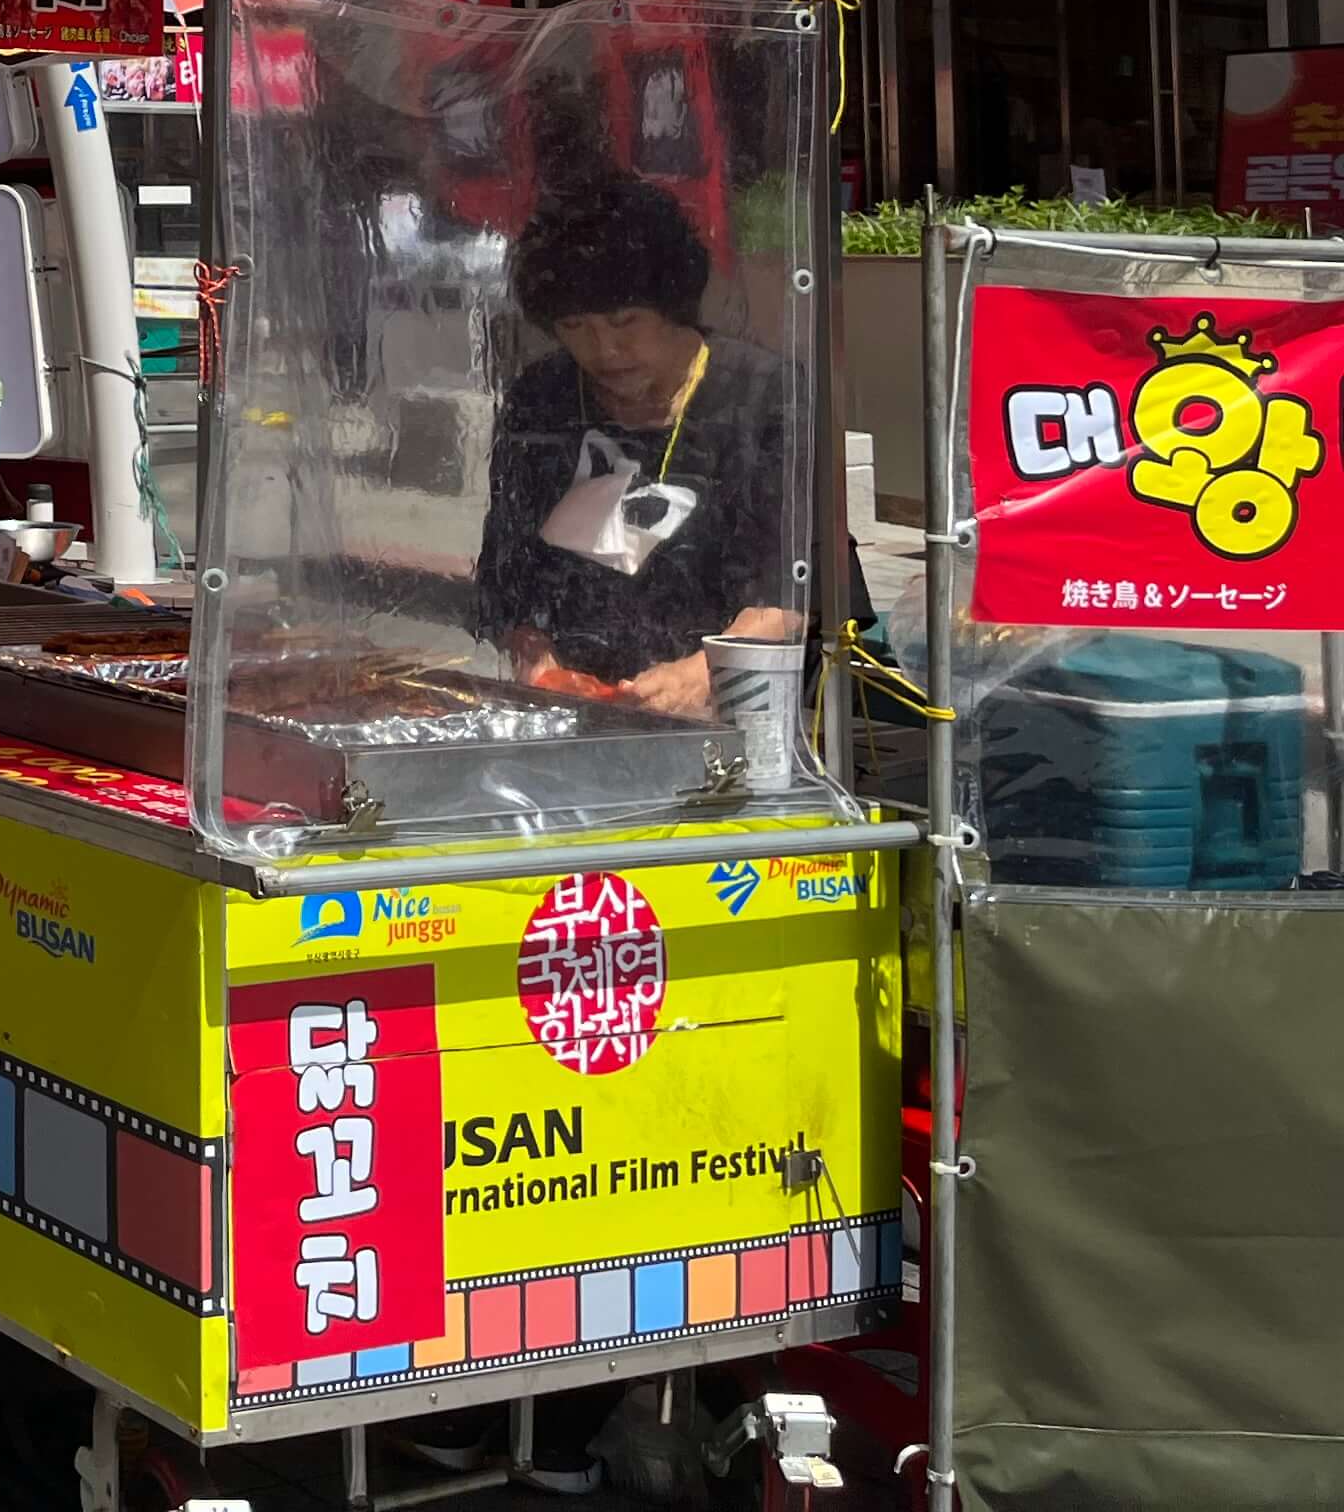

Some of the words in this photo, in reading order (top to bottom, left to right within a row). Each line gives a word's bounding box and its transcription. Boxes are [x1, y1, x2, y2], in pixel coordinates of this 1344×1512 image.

[1004, 346, 1326, 562] 대왕
[373, 890, 431, 922] Nice
[796, 875, 868, 903] BUSAN
[15, 914, 95, 964] BUSAN
[386, 915, 457, 946] junggu
[288, 999, 380, 1335] 닭꼬치
[608, 1153, 680, 1195] Film
